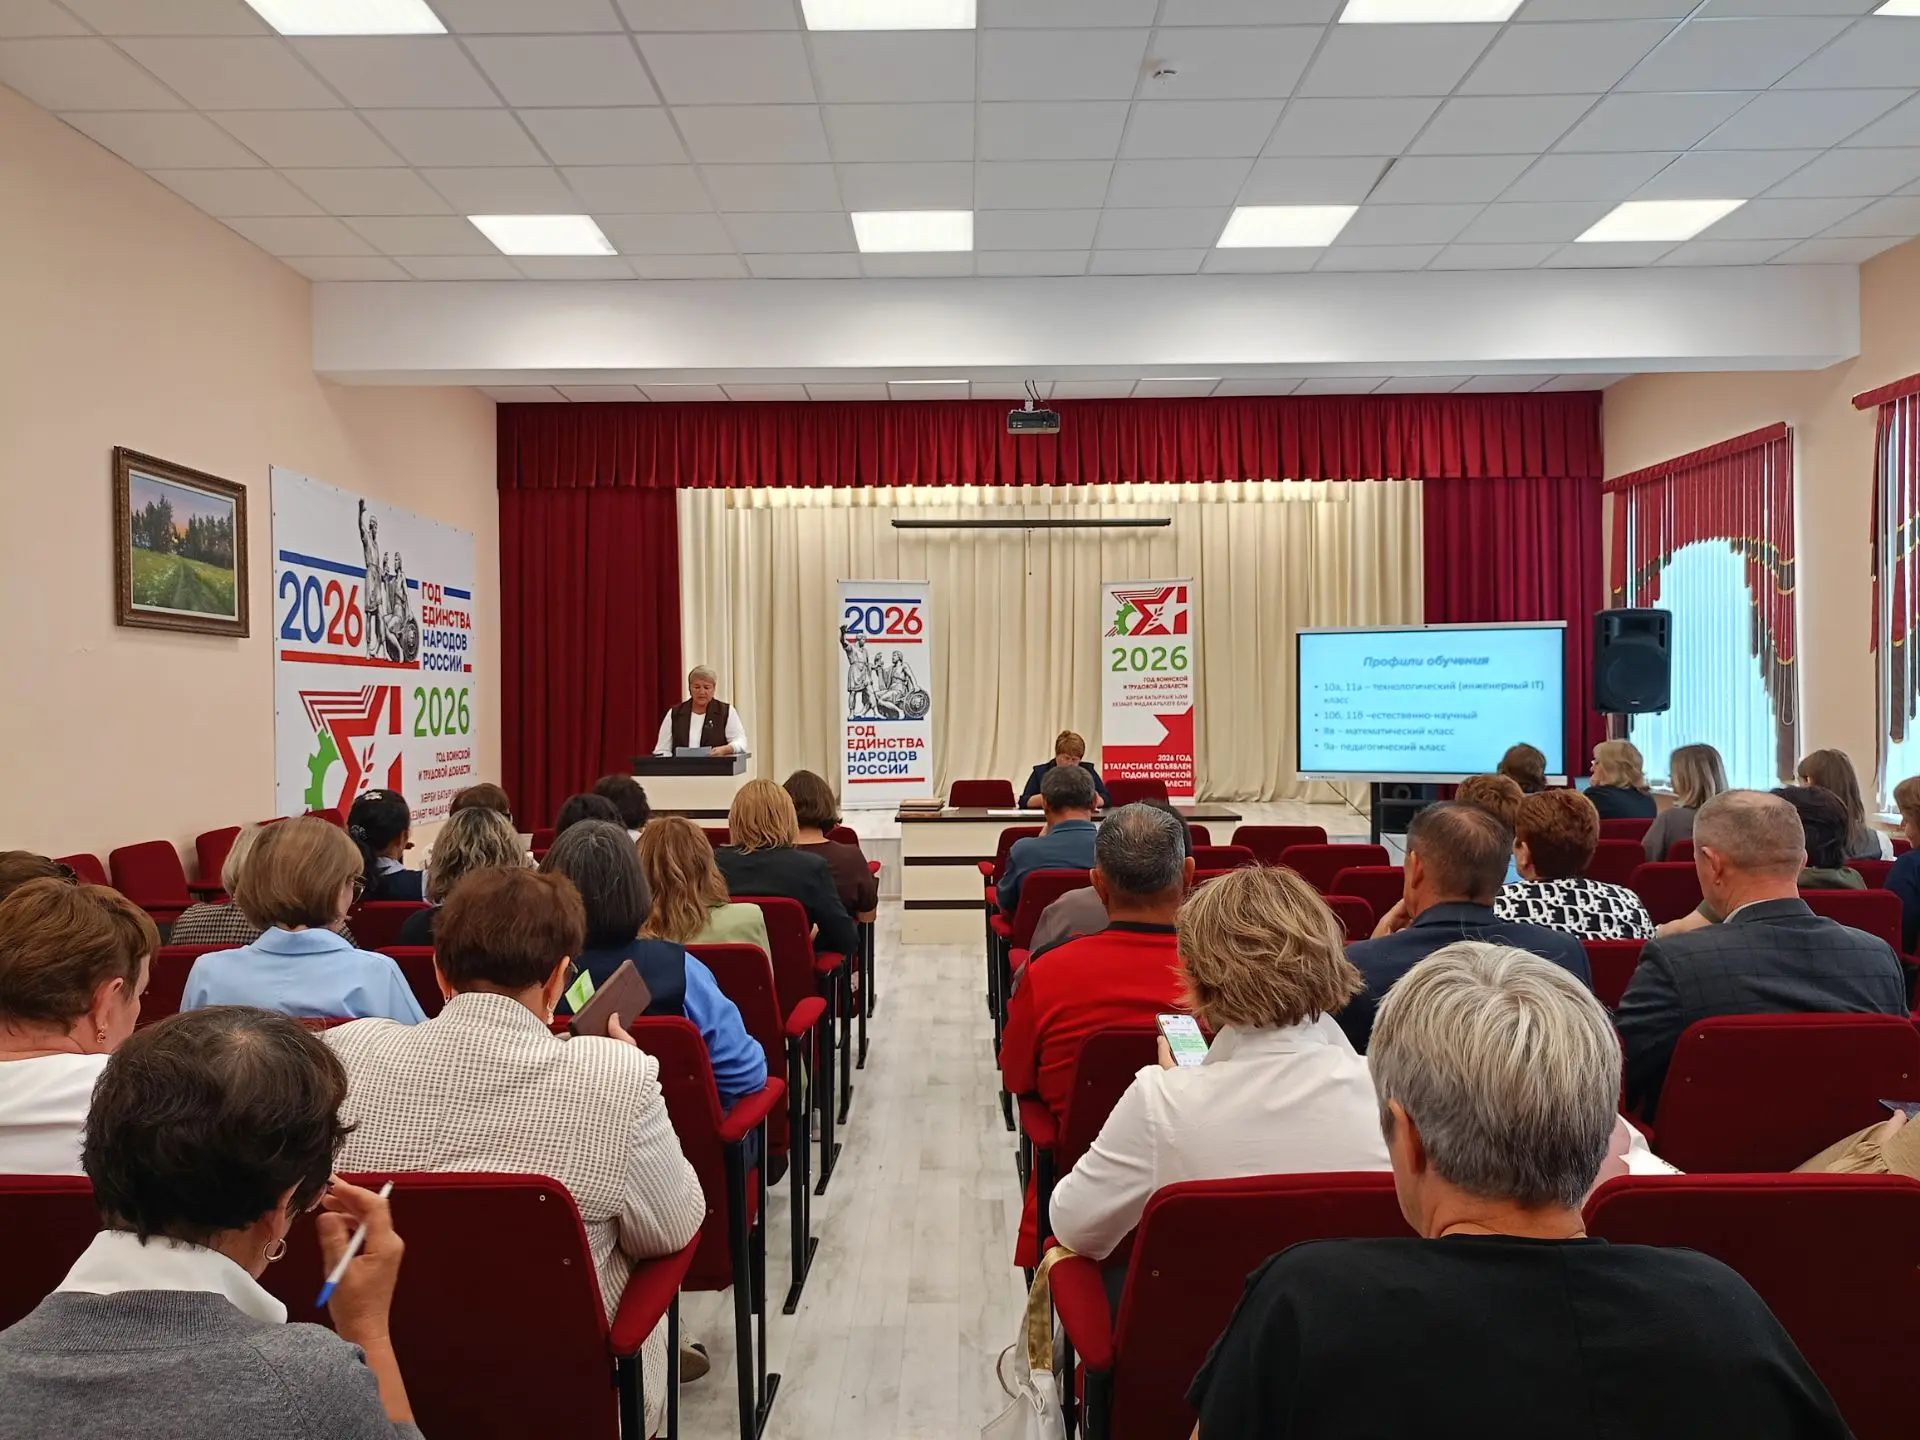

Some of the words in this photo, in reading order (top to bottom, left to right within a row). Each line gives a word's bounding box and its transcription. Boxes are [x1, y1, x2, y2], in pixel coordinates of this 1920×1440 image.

[422, 582, 442, 605] ГОД
[279, 571, 363, 648] 2026
[422, 606, 471, 630] ЕДИНСТВА
[845, 606, 923, 635] 2026
[422, 630, 467, 653] НАРОДОВ
[423, 653, 463, 673] РОССИИ
[1111, 645, 1188, 672] 2026
[1363, 656, 1424, 669] Профили
[1427, 655, 1490, 668] обучения
[1373, 681, 1456, 691] технологический
[1458, 680, 1529, 692] (инженерный
[1531, 680, 1545, 692] IT)
[1324, 697, 1350, 705] класс
[413, 687, 471, 738] 2026
[847, 725, 876, 738] ГОД
[1345, 726, 1425, 736] математический
[1428, 728, 1455, 736] класс
[847, 738, 925, 751] ЕДИНСТВА
[1340, 742, 1417, 752] педагогический
[1420, 744, 1446, 752] класс
[436, 751, 446, 763] ГОД
[446, 747, 471, 761] ВОИНСКОЙ
[847, 751, 917, 763] НАРОДОВ
[1157, 754, 1174, 762] 2026
[1176, 754, 1192, 762] ГОД
[423, 765, 448, 780] ТРУДОВОЙ
[448, 764, 471, 777] ДОБЛЕСТИ
[847, 764, 909, 776] РОССИИ
[1150, 771, 1192, 779] ВОИНСКОЙ
[1164, 780, 1192, 788] БЛЕСТИ
[409, 808, 428, 820] ЕЗМӘТ
